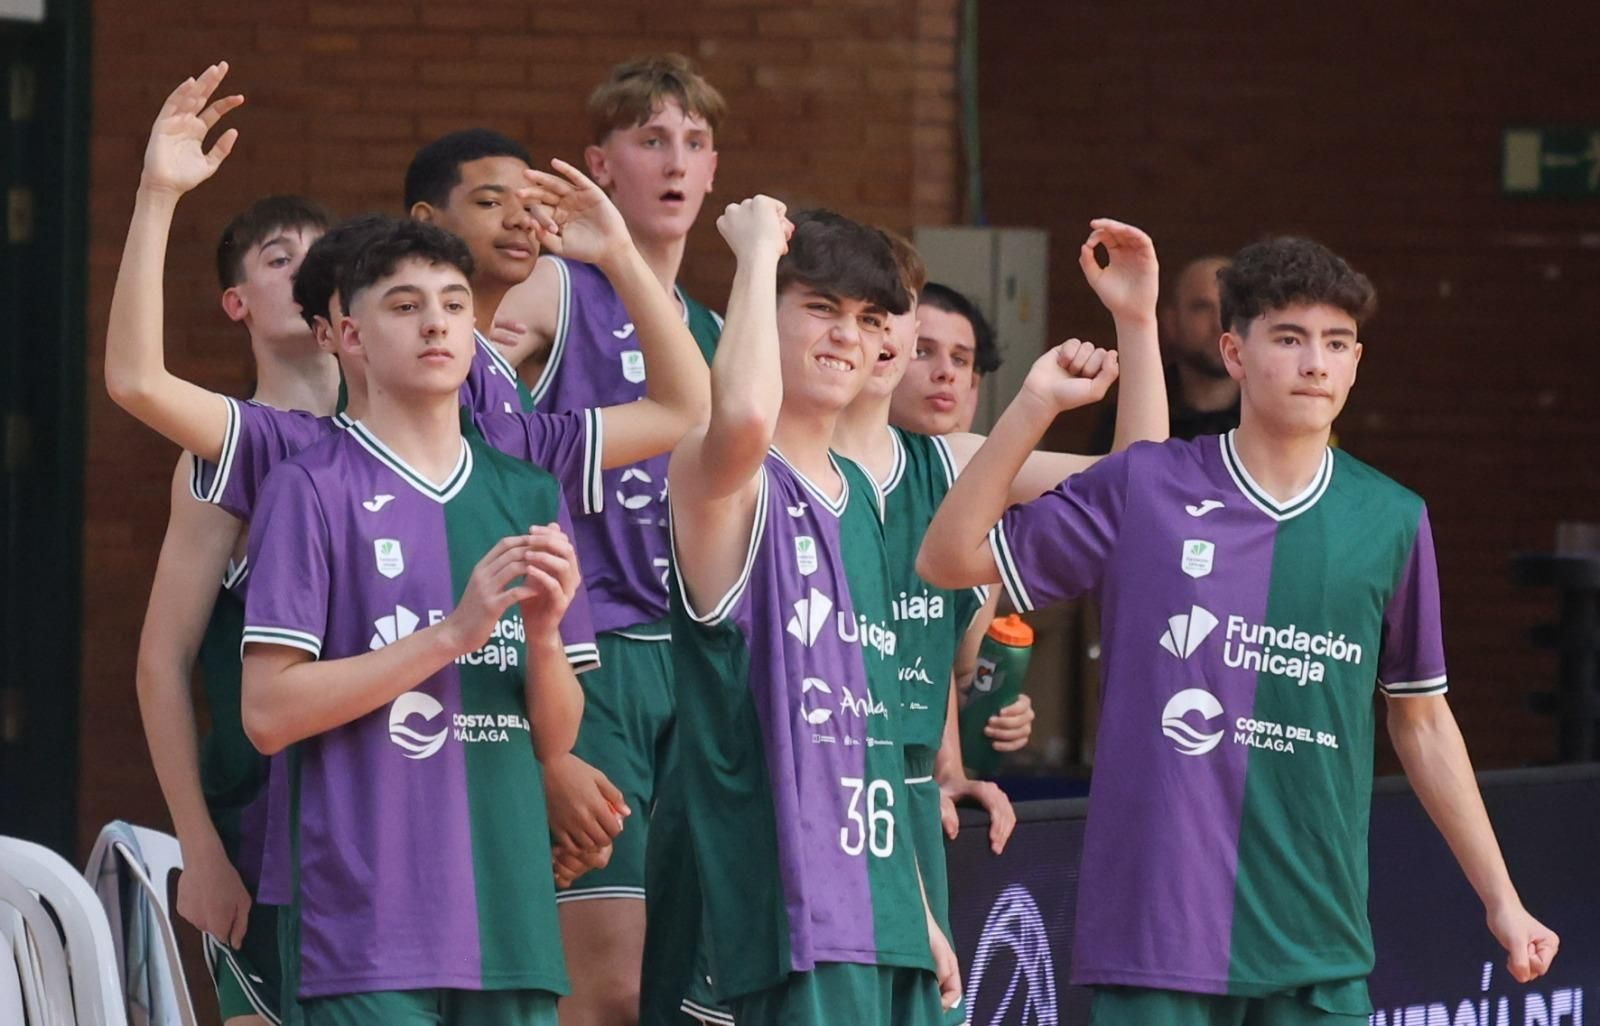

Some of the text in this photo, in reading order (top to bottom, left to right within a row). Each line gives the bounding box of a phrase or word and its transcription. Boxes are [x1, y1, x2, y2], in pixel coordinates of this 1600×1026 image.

[1226, 614, 1362, 665] Fundación
[1222, 641, 1326, 686] Unicaja
[453, 713, 495, 728] COSTA
[497, 714, 522, 729] DEL
[453, 727, 509, 743] MÁLAGA
[1235, 717, 1339, 749] COSTA DEL SOL
[1233, 731, 1295, 754] MÁLAGA
[840, 776, 895, 858] 36
